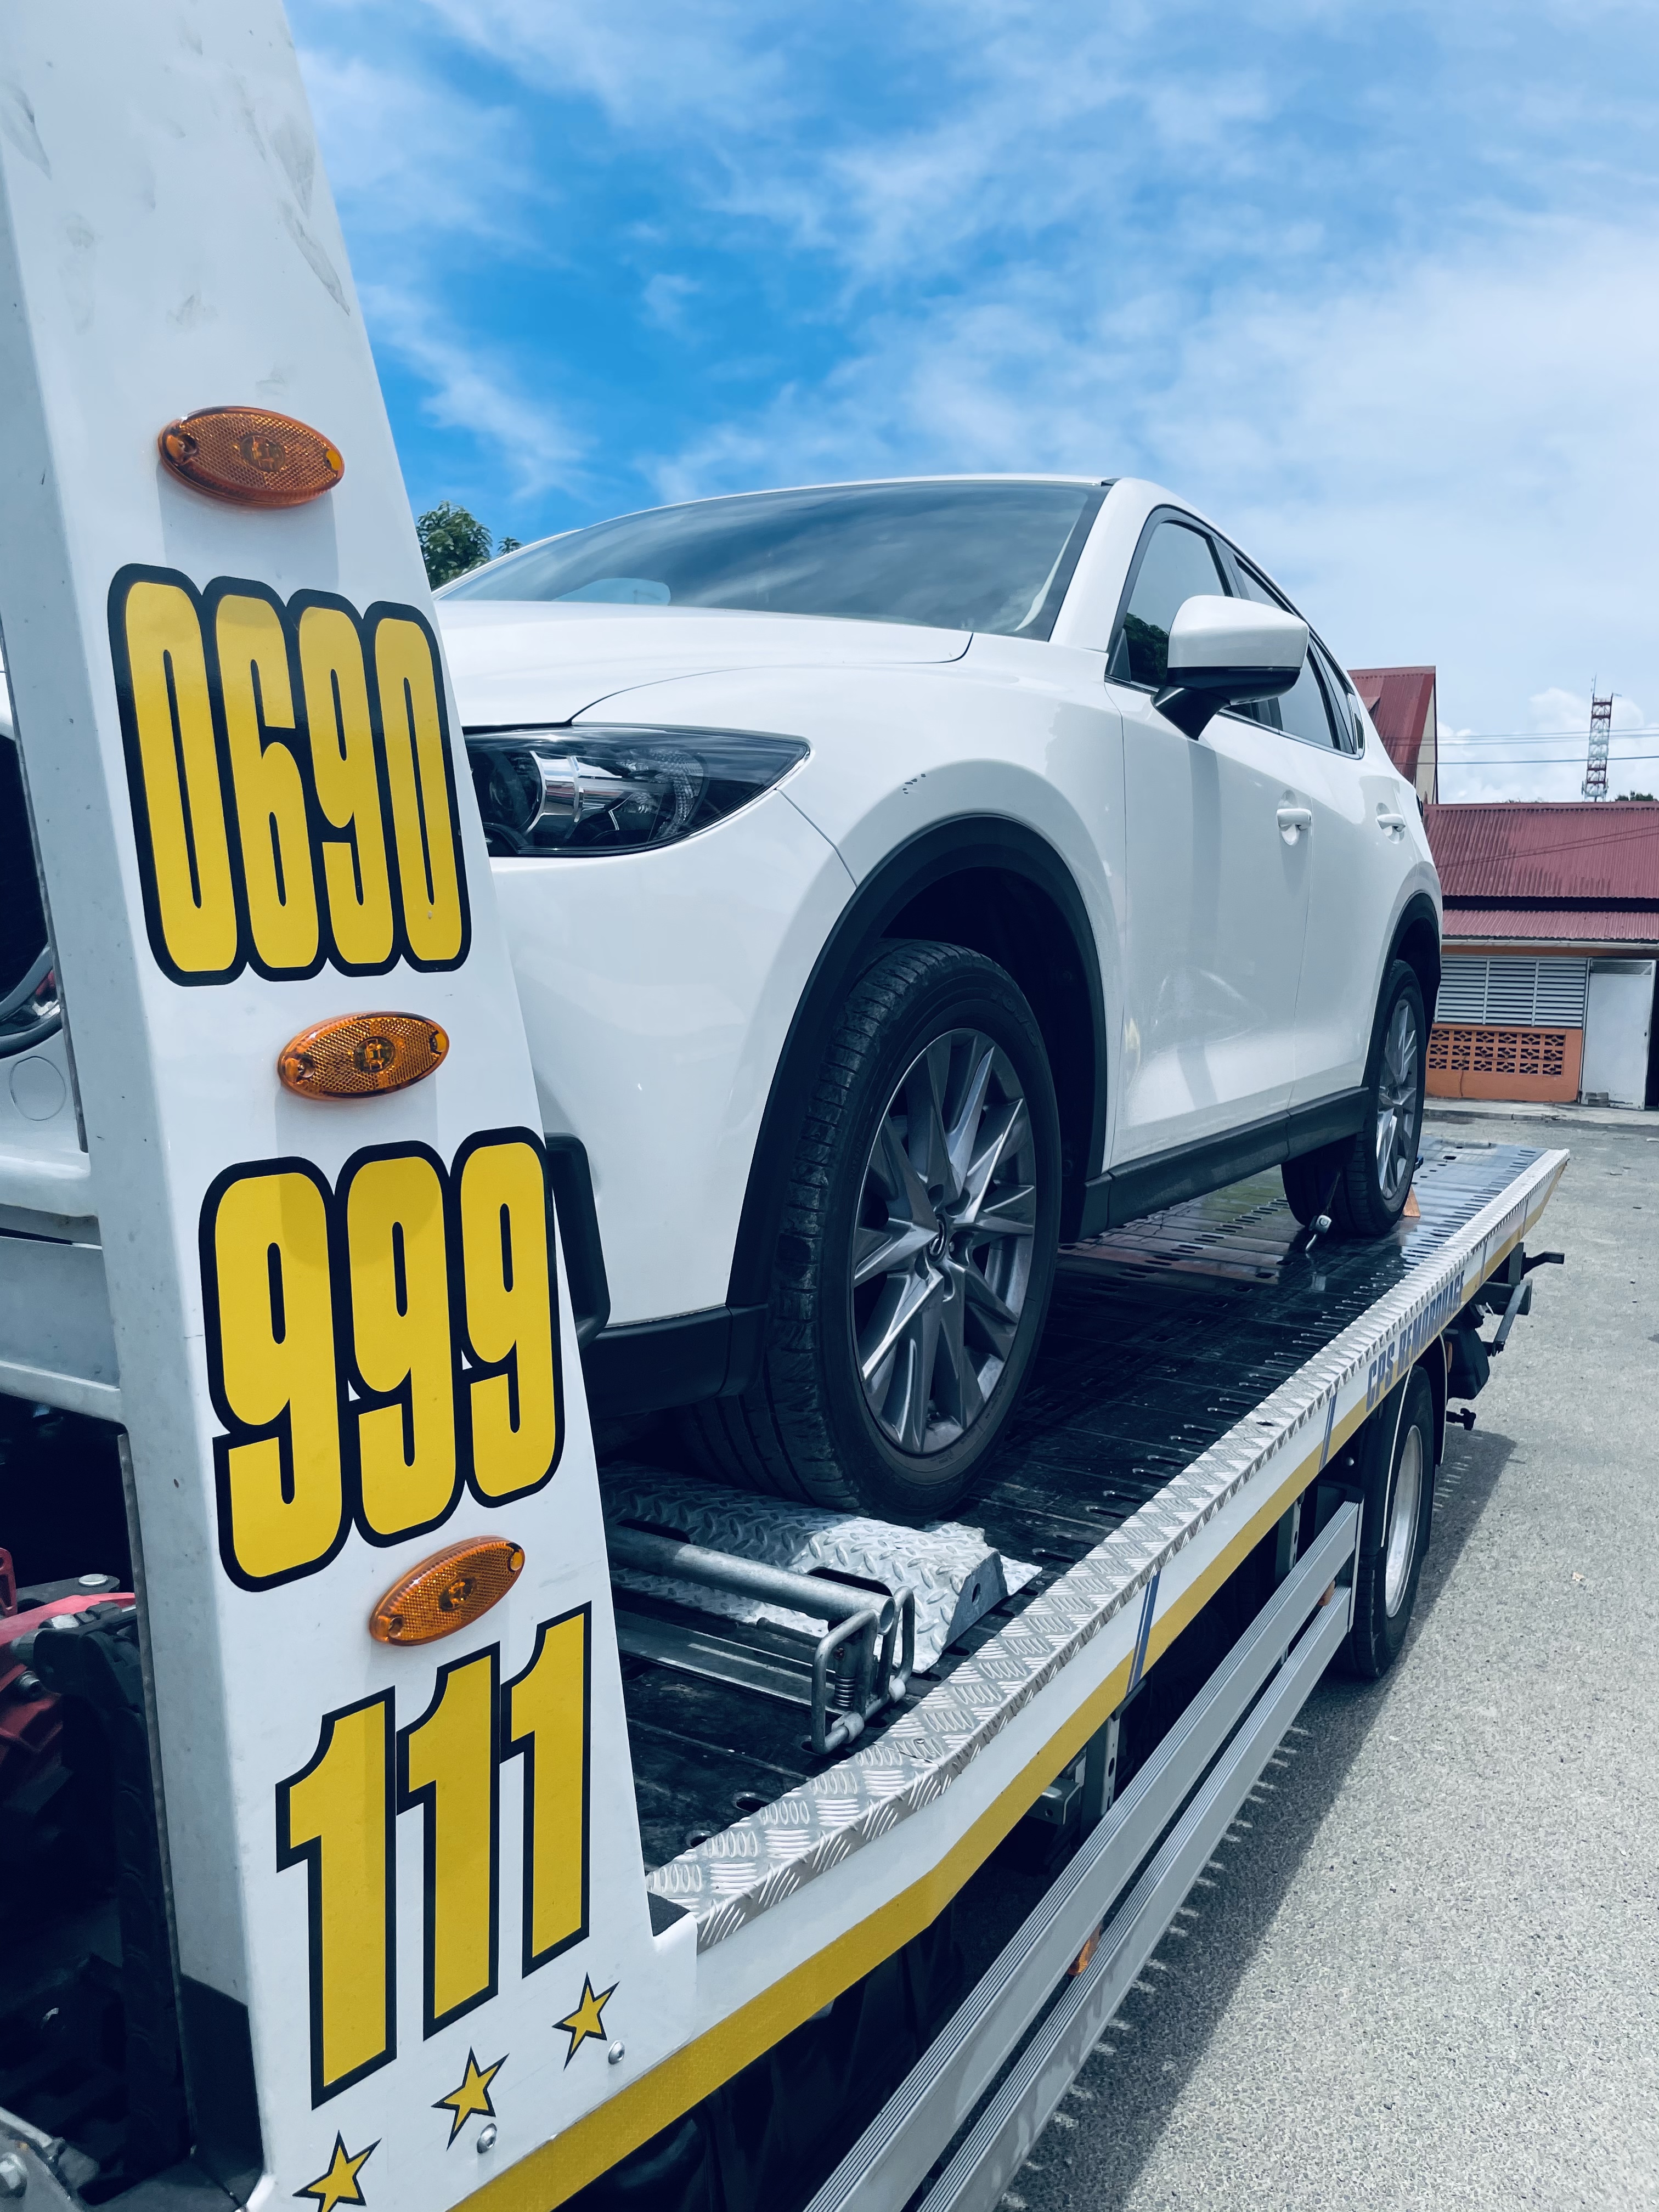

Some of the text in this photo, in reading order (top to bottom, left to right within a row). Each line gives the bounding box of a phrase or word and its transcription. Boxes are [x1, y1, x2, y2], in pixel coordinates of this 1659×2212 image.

[108, 563, 471, 987] 0690
[199, 1126, 565, 1592] 999
[1366, 1269, 1465, 1412] CPS REMORQUAGE
[276, 1600, 591, 2111] 111
